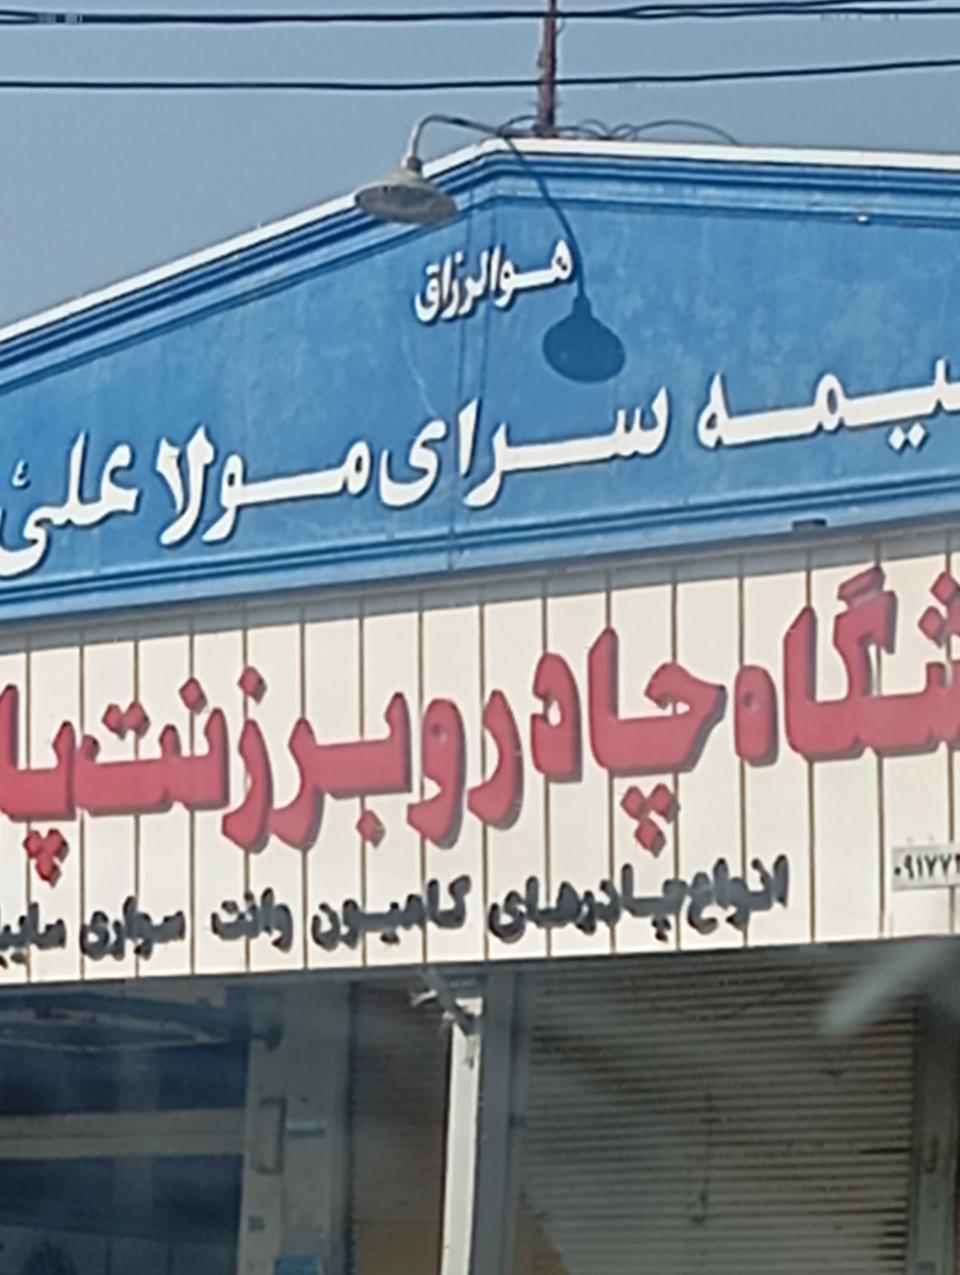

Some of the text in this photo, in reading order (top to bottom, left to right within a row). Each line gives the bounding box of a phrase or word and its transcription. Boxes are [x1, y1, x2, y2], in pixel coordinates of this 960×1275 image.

[379, 386, 669, 508] سرای
[697, 358, 960, 451] یمه
[156, 425, 372, 546] مولا
[73, 666, 412, 853] برزنت
[467, 627, 727, 855] چادر
[81, 896, 185, 961] سواری
[211, 887, 293, 951] وانت
[311, 875, 471, 951] کامیون
[686, 854, 789, 934] انواع
